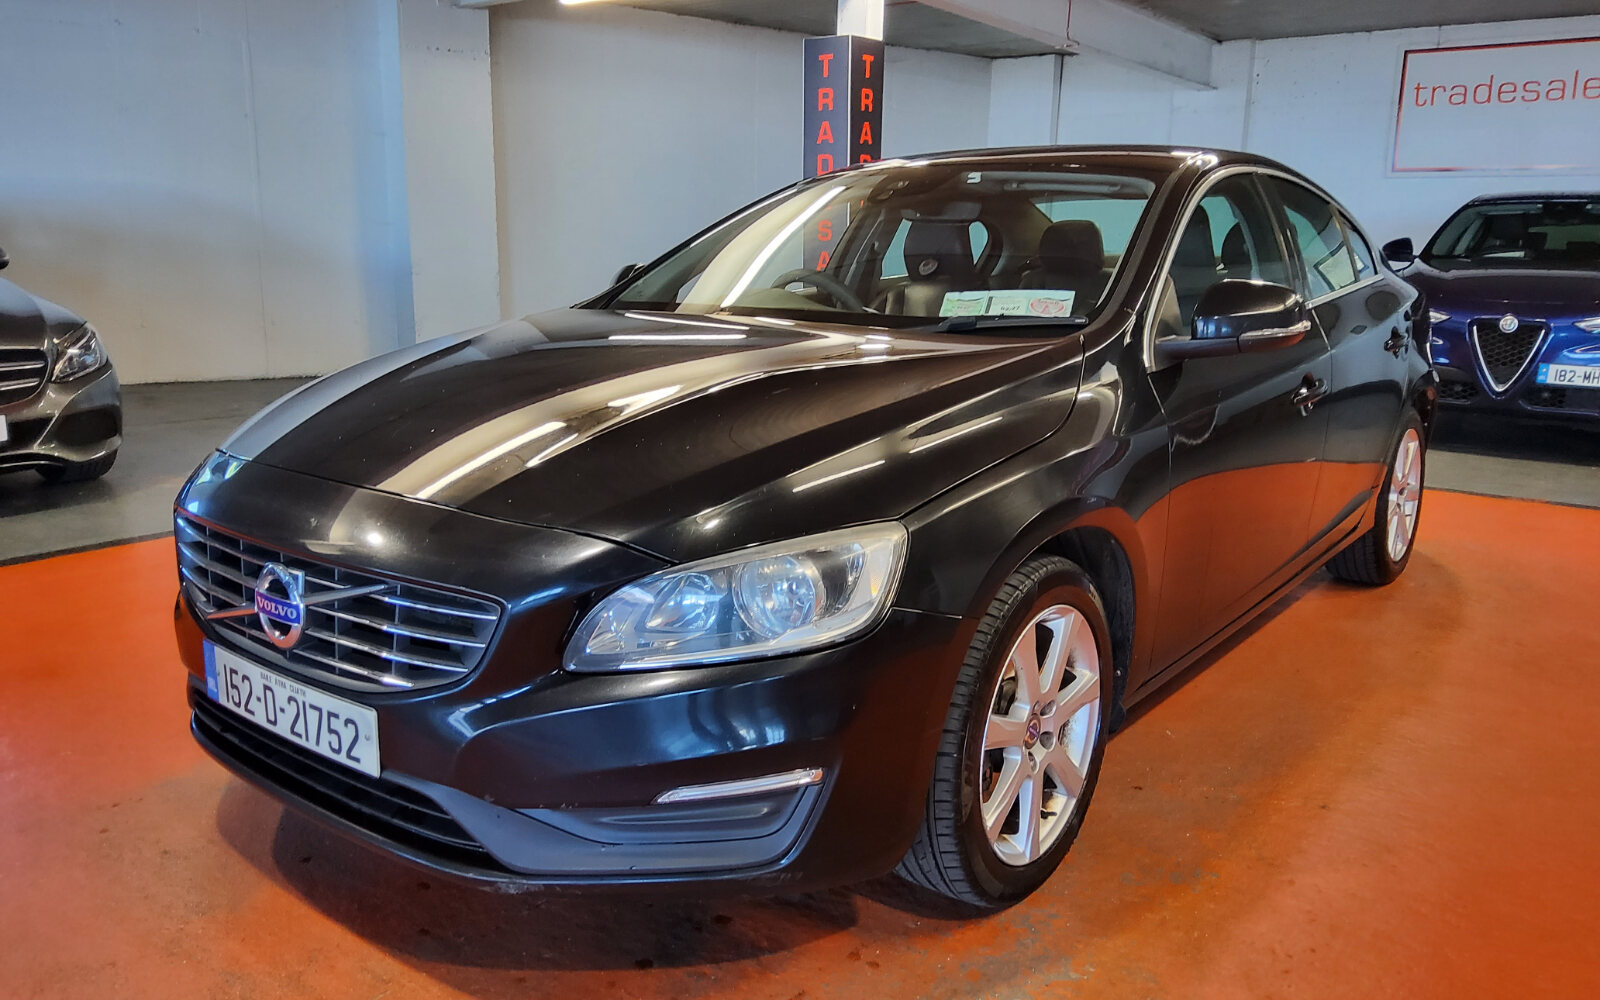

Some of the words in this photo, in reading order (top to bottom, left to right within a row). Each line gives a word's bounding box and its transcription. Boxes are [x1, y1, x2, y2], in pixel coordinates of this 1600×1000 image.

[1414, 69, 1600, 107] tradesale
[1553, 368, 1600, 385] 182-MH
[257, 596, 298, 620] VOLVO
[223, 663, 361, 764] 152-D-21752
